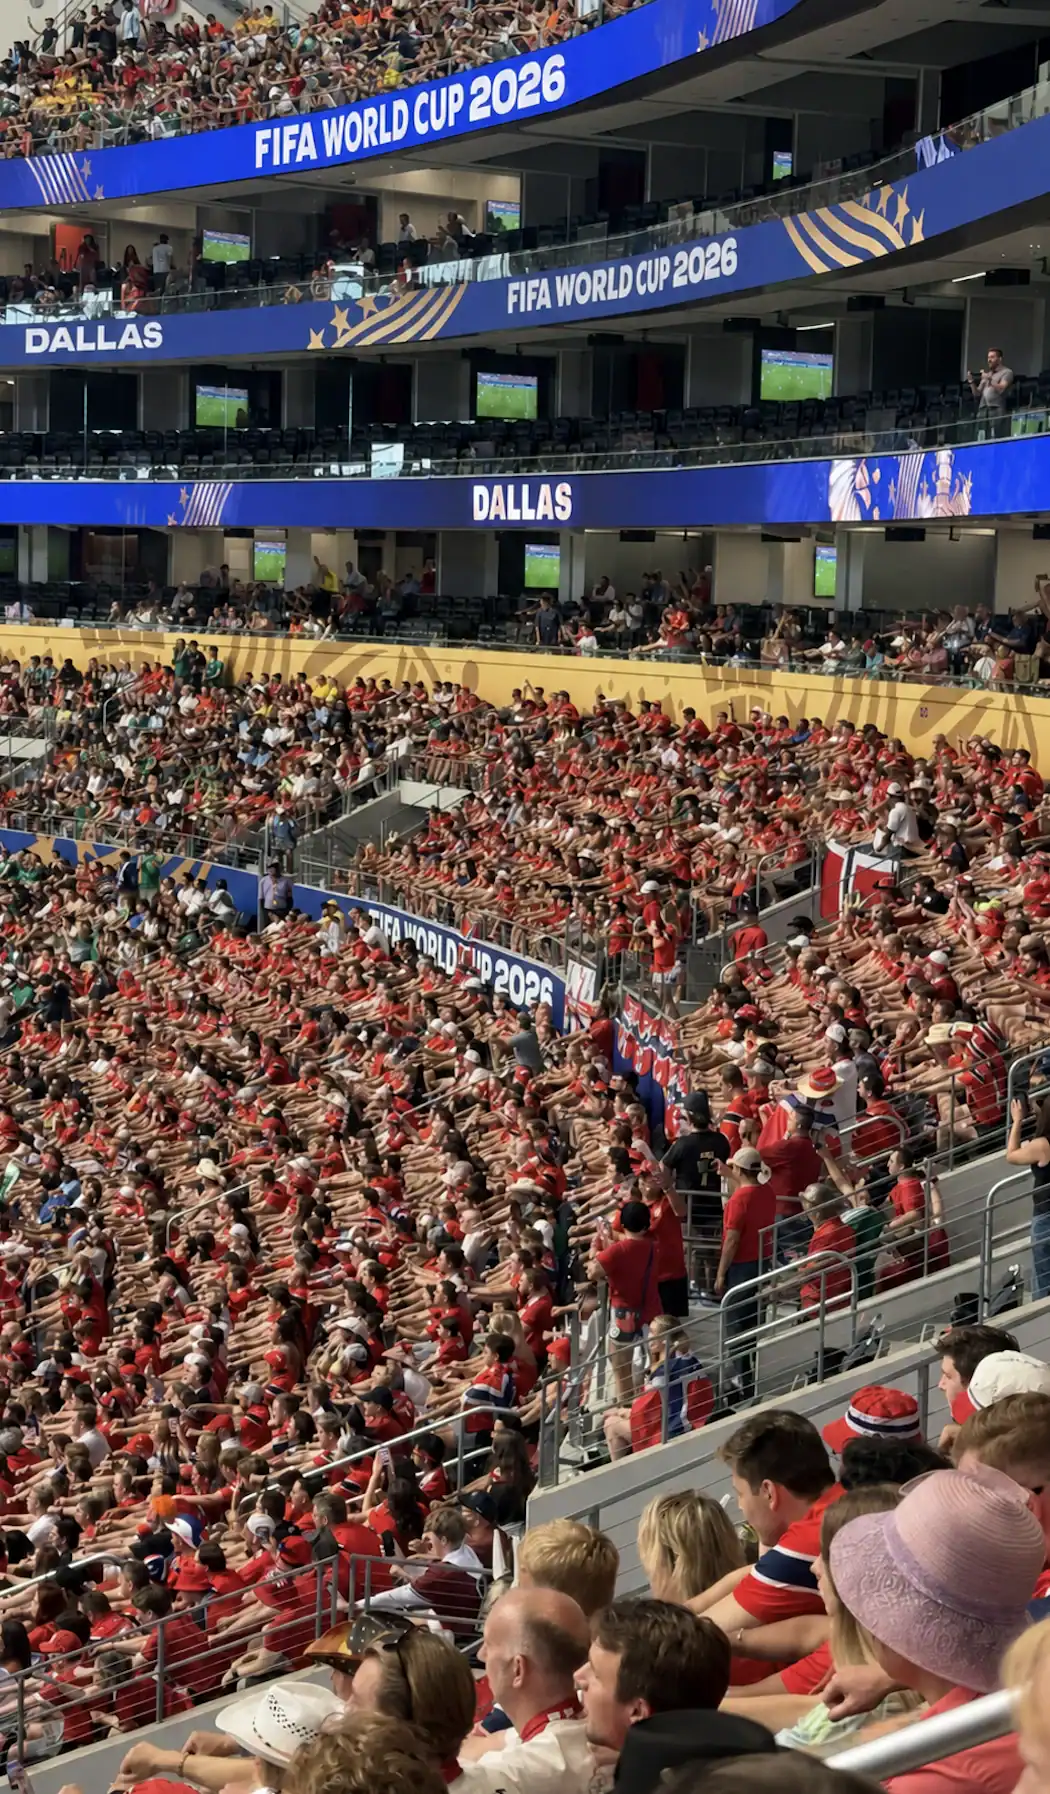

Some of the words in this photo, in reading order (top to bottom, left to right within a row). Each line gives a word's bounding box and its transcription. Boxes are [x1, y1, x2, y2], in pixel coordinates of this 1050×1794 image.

[255, 121, 317, 168] FIFA
[321, 98, 409, 157] WORLD
[413, 82, 465, 135] CUP
[468, 53, 566, 122] 2026
[507, 277, 552, 314] FIFA
[555, 264, 633, 307] WORLD
[636, 255, 671, 296] CUP
[672, 237, 738, 288] 2026
[25, 321, 163, 354] DALLAS
[473, 482, 572, 521] DALLAS
[493, 958, 553, 1008] 2026
